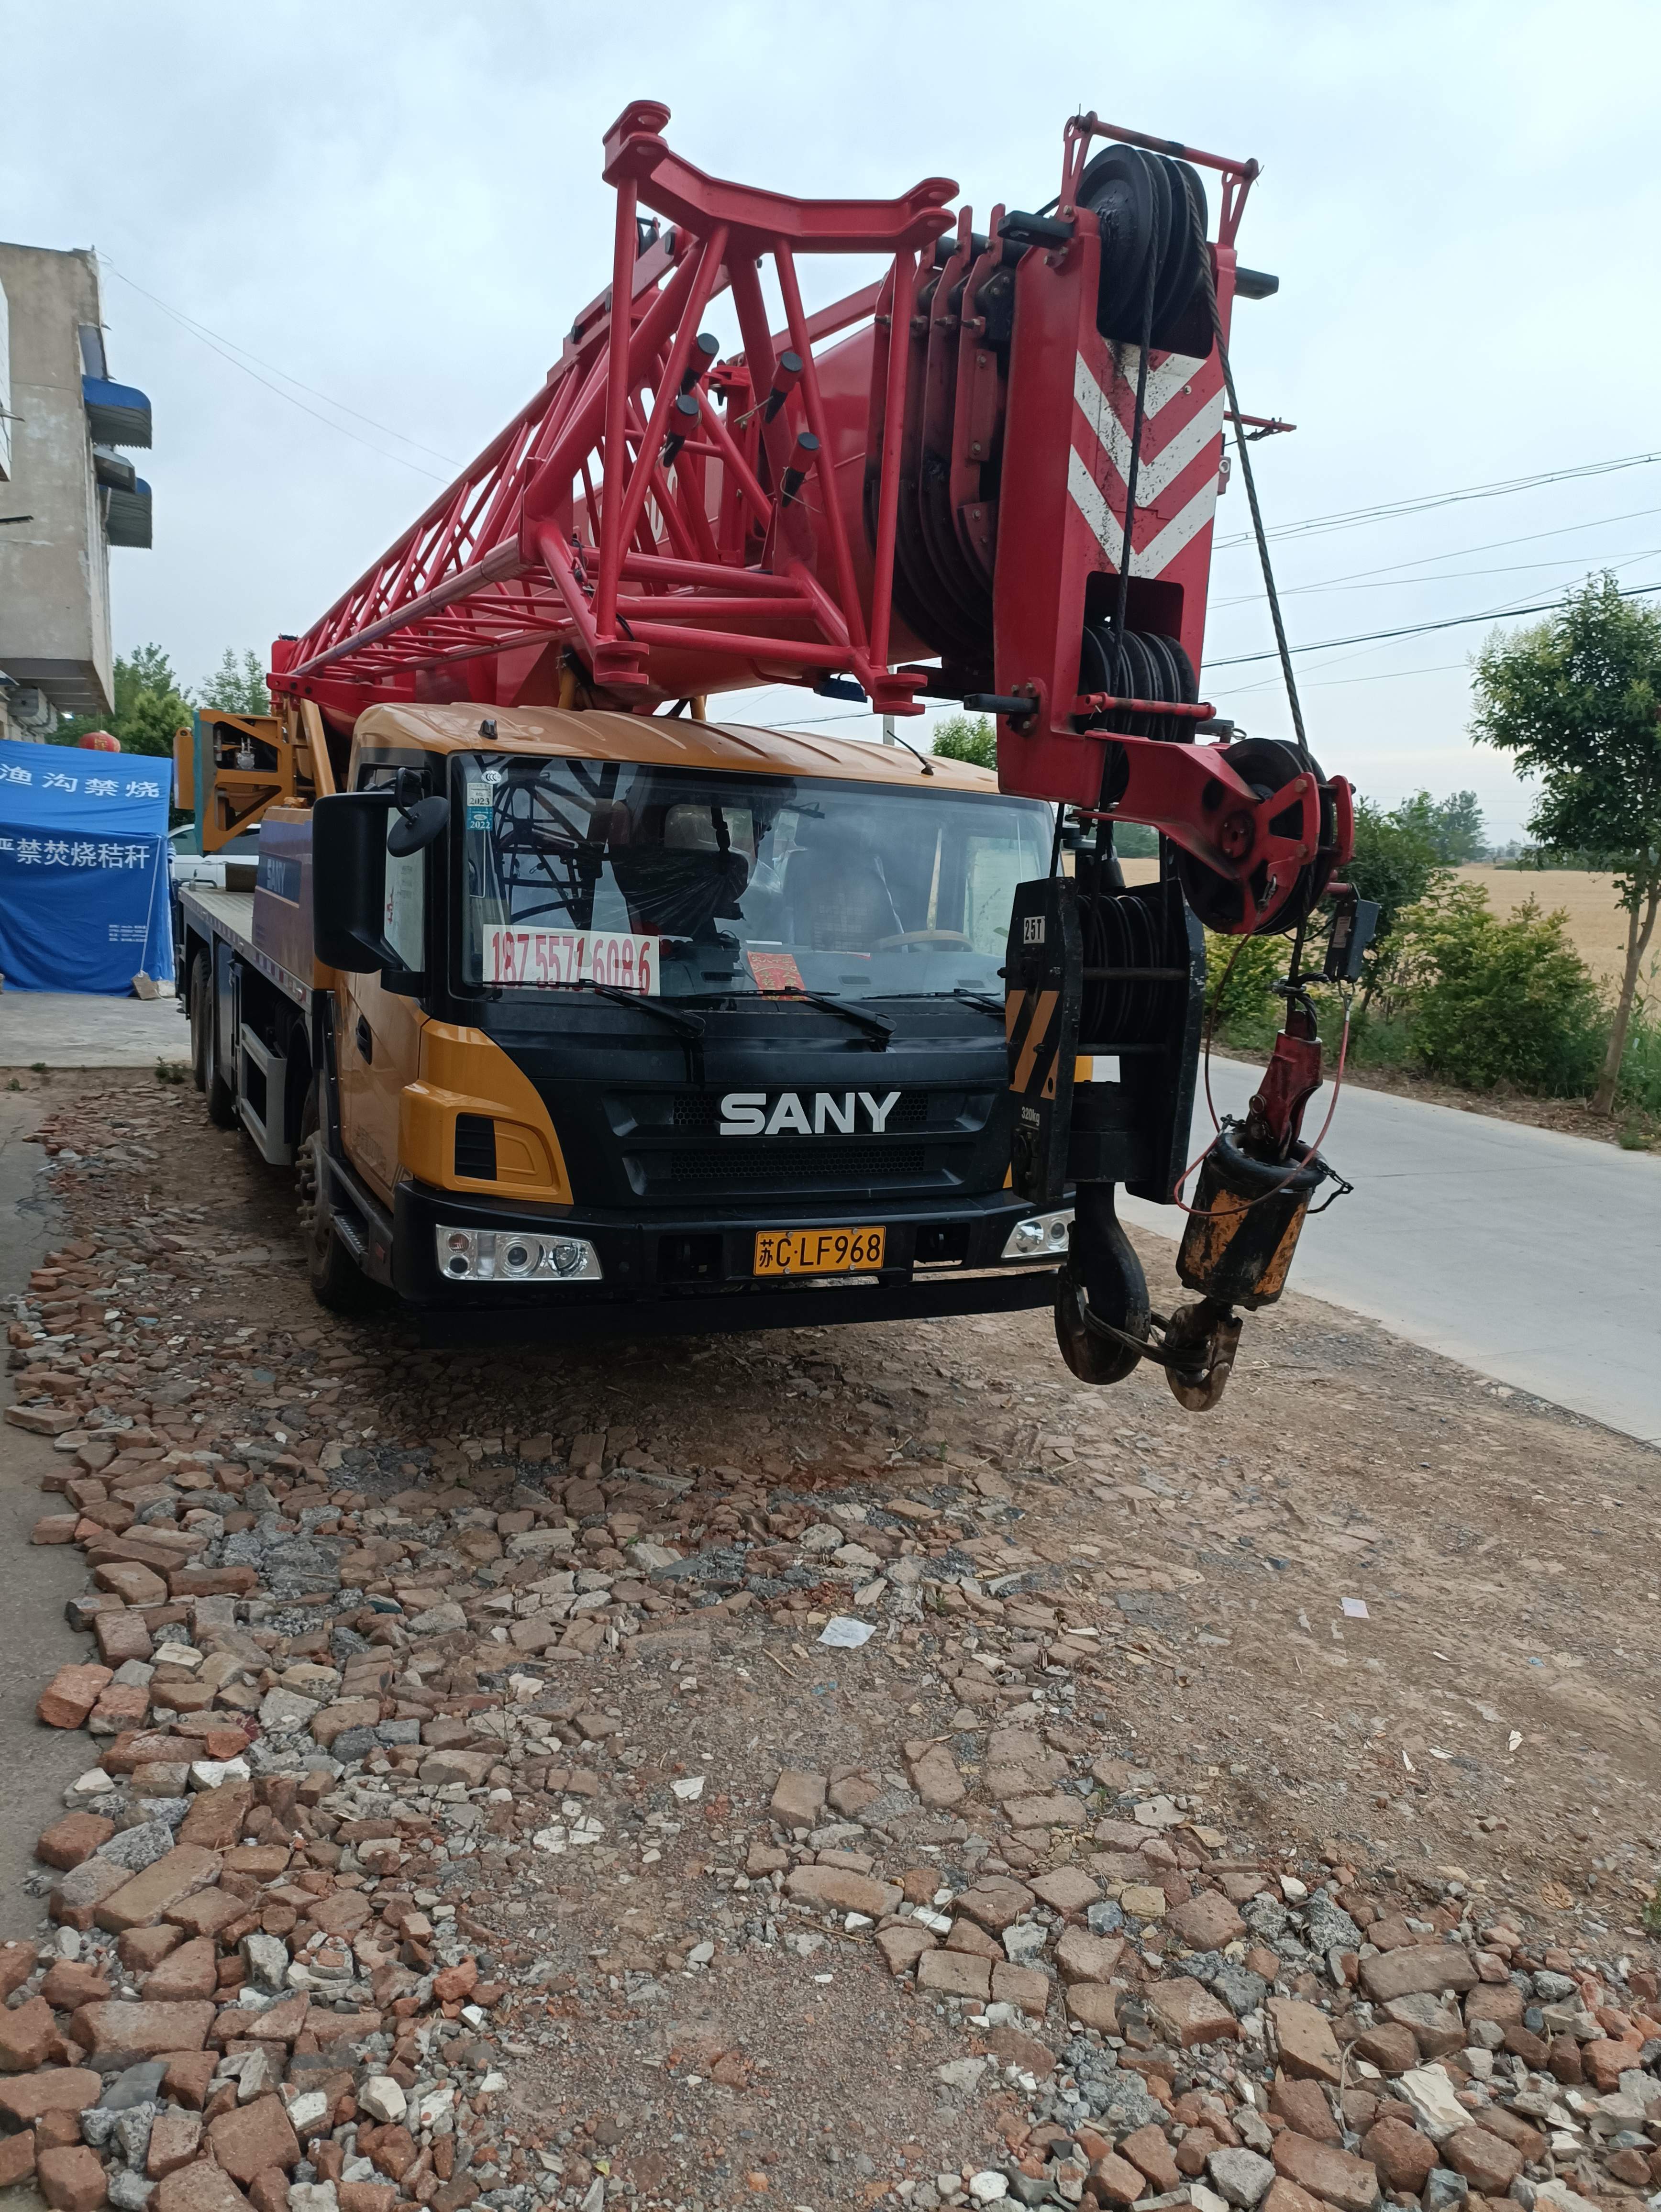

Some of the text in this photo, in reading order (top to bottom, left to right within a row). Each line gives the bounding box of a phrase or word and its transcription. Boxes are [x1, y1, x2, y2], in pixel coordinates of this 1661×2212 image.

[469, 797, 490, 806] 2023
[470, 820, 490, 829] 2022
[1025, 918, 1042, 941] 25T
[720, 1092, 901, 1135] SANY
[1021, 1106, 1040, 1127] 320kg
